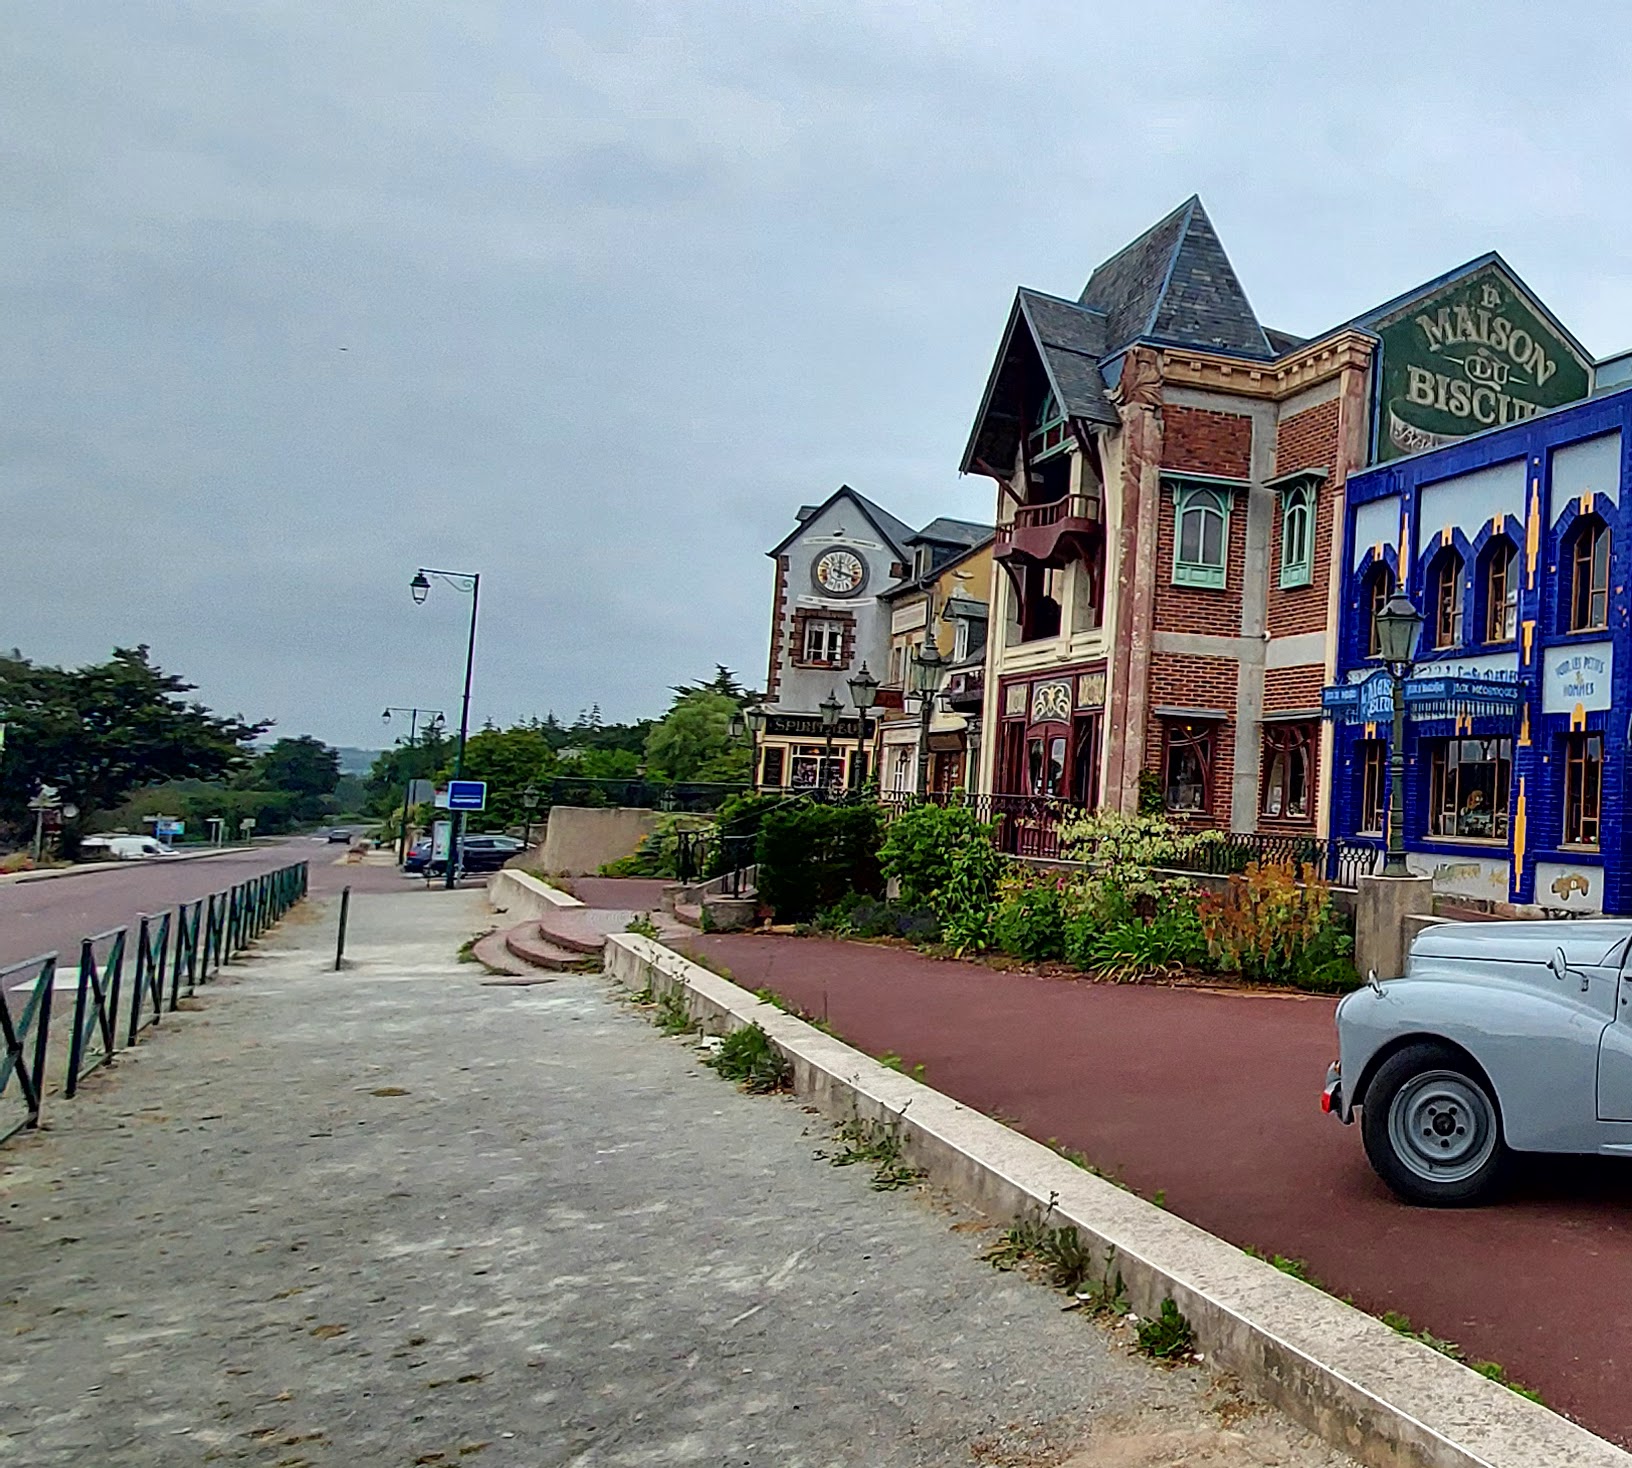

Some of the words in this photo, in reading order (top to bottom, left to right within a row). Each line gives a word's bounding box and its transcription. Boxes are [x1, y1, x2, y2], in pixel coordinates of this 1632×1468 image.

[1481, 284, 1502, 308] LA
[1415, 305, 1557, 387] MAISON
[1406, 364, 1541, 425] BISCUI
[1464, 352, 1510, 390] DU
